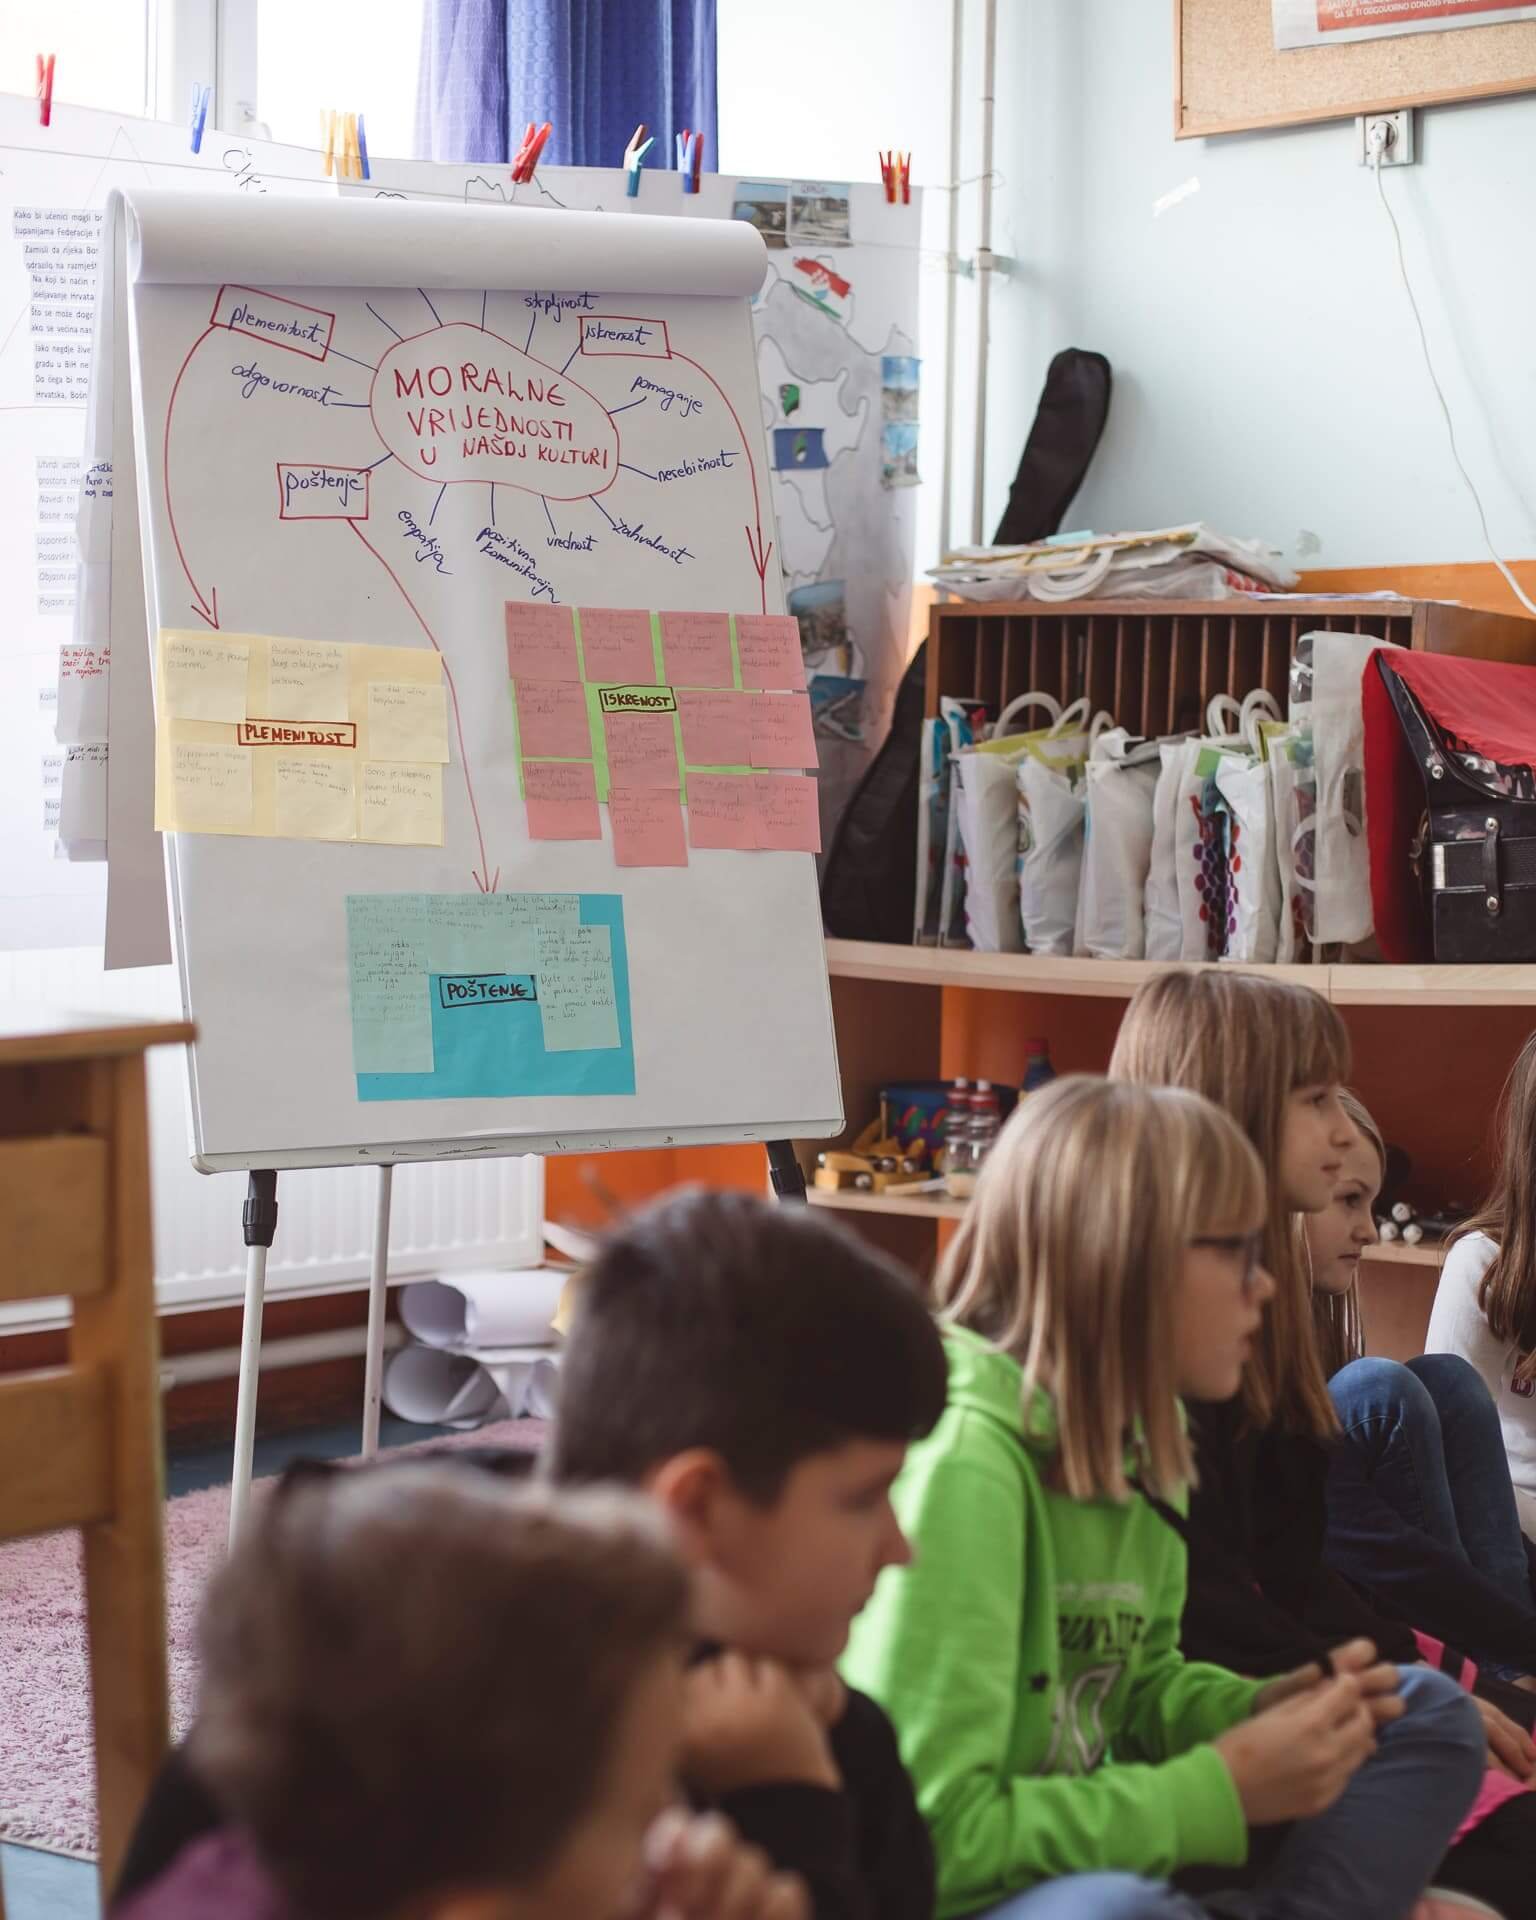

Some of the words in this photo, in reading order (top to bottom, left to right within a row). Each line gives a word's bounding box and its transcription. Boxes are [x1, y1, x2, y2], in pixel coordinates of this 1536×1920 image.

[229, 303, 325, 343] plemenitost
[231, 362, 343, 406] odgovornost
[394, 362, 566, 406] MORALNE
[630, 375, 703, 417] pomaganje
[407, 405, 573, 442] VRIJEDNOSTI
[420, 446, 437, 465] U
[538, 444, 608, 470] KULTURI
[286, 470, 365, 507] poštenje
[398, 510, 454, 576] empatija
[603, 691, 672, 707] ISKRENOST
[245, 723, 347, 745] PLEMENITOST
[447, 978, 530, 1001] POŠTENJE
